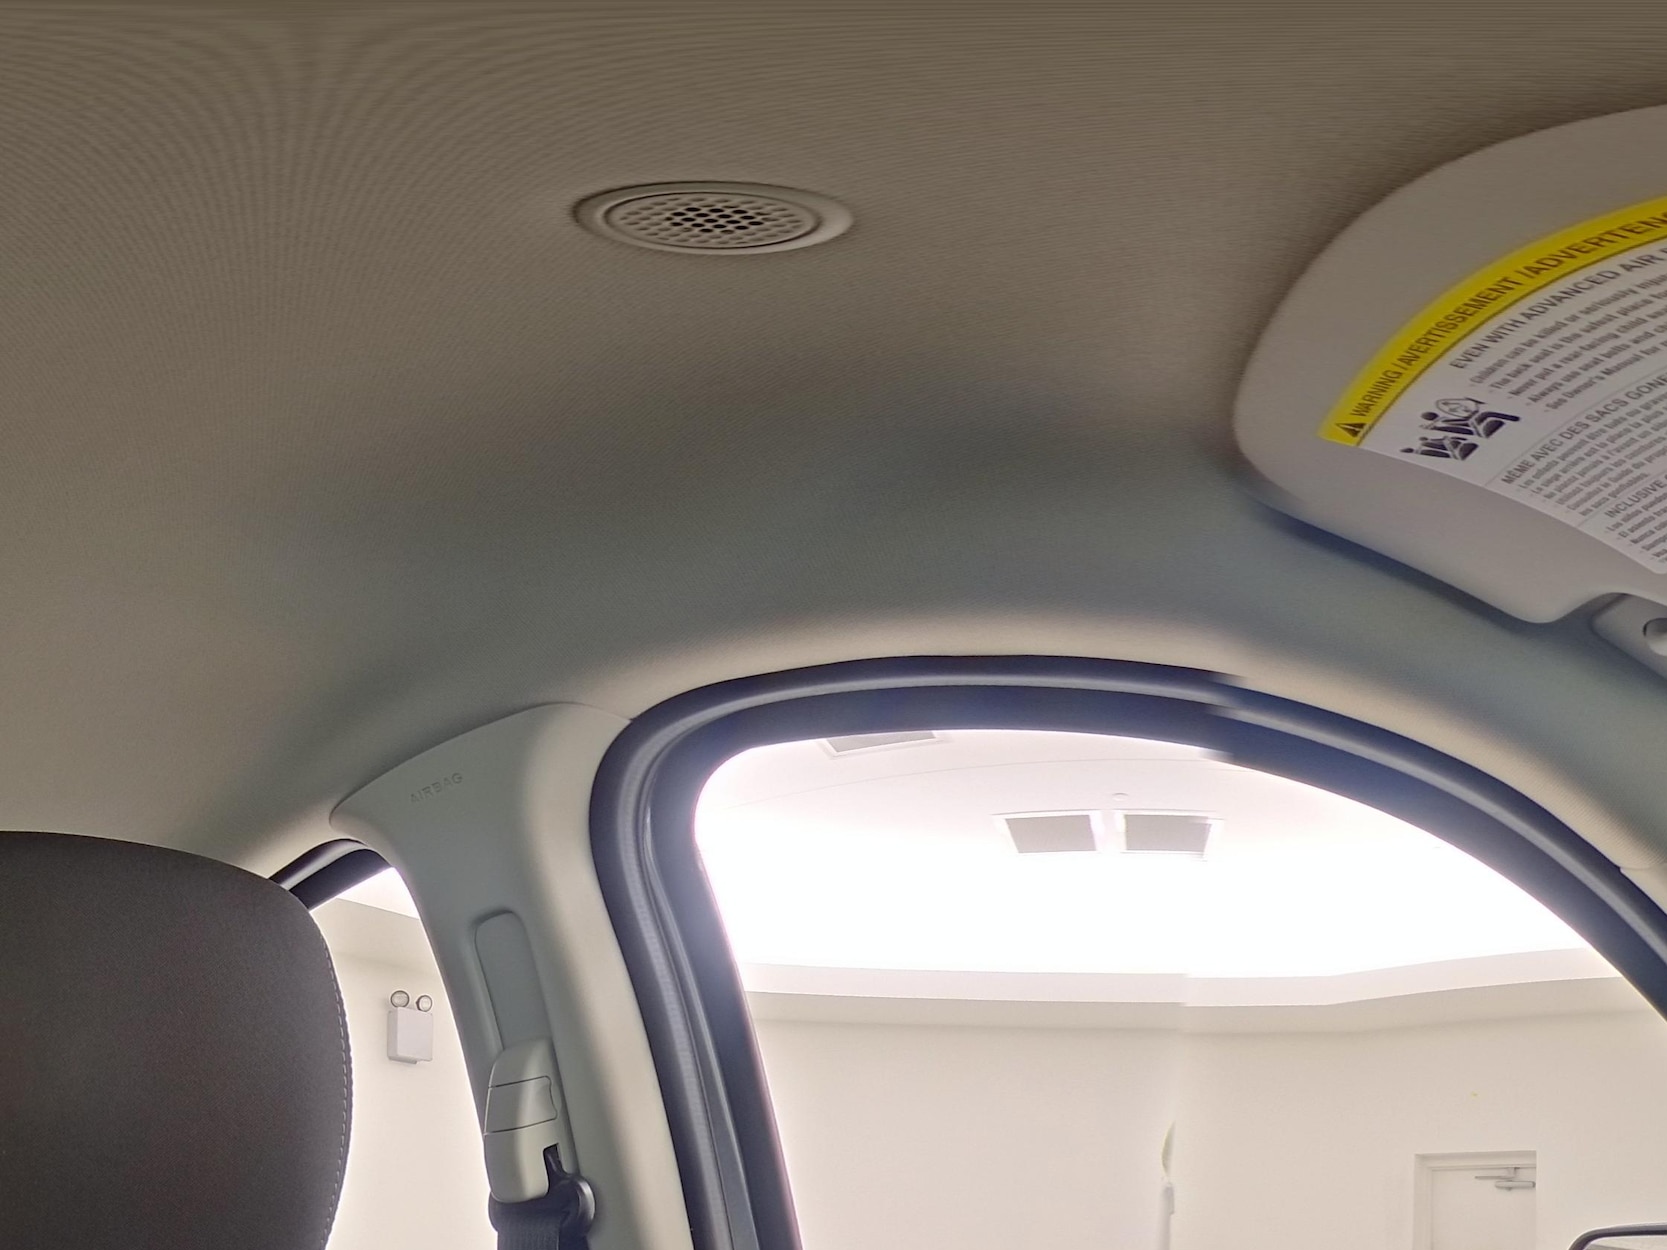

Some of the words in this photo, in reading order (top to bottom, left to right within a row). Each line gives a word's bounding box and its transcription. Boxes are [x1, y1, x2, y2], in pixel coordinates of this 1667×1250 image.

[1348, 369, 1405, 418] WARNING
[1389, 278, 1525, 370] /AVERTISSEMENT
[1448, 342, 1492, 369] EVEN
[1480, 318, 1527, 343] WITH
[1515, 269, 1624, 320] ADVANCED
[1613, 253, 1666, 272] AIR
[1498, 459, 1536, 484] MÊME
[1527, 438, 1565, 461] AVEC
[1557, 420, 1592, 440] DES
[1583, 397, 1630, 423] SACS
[1603, 479, 1667, 518] INCLUSIVE
[410, 772, 463, 803] AIRBAG
